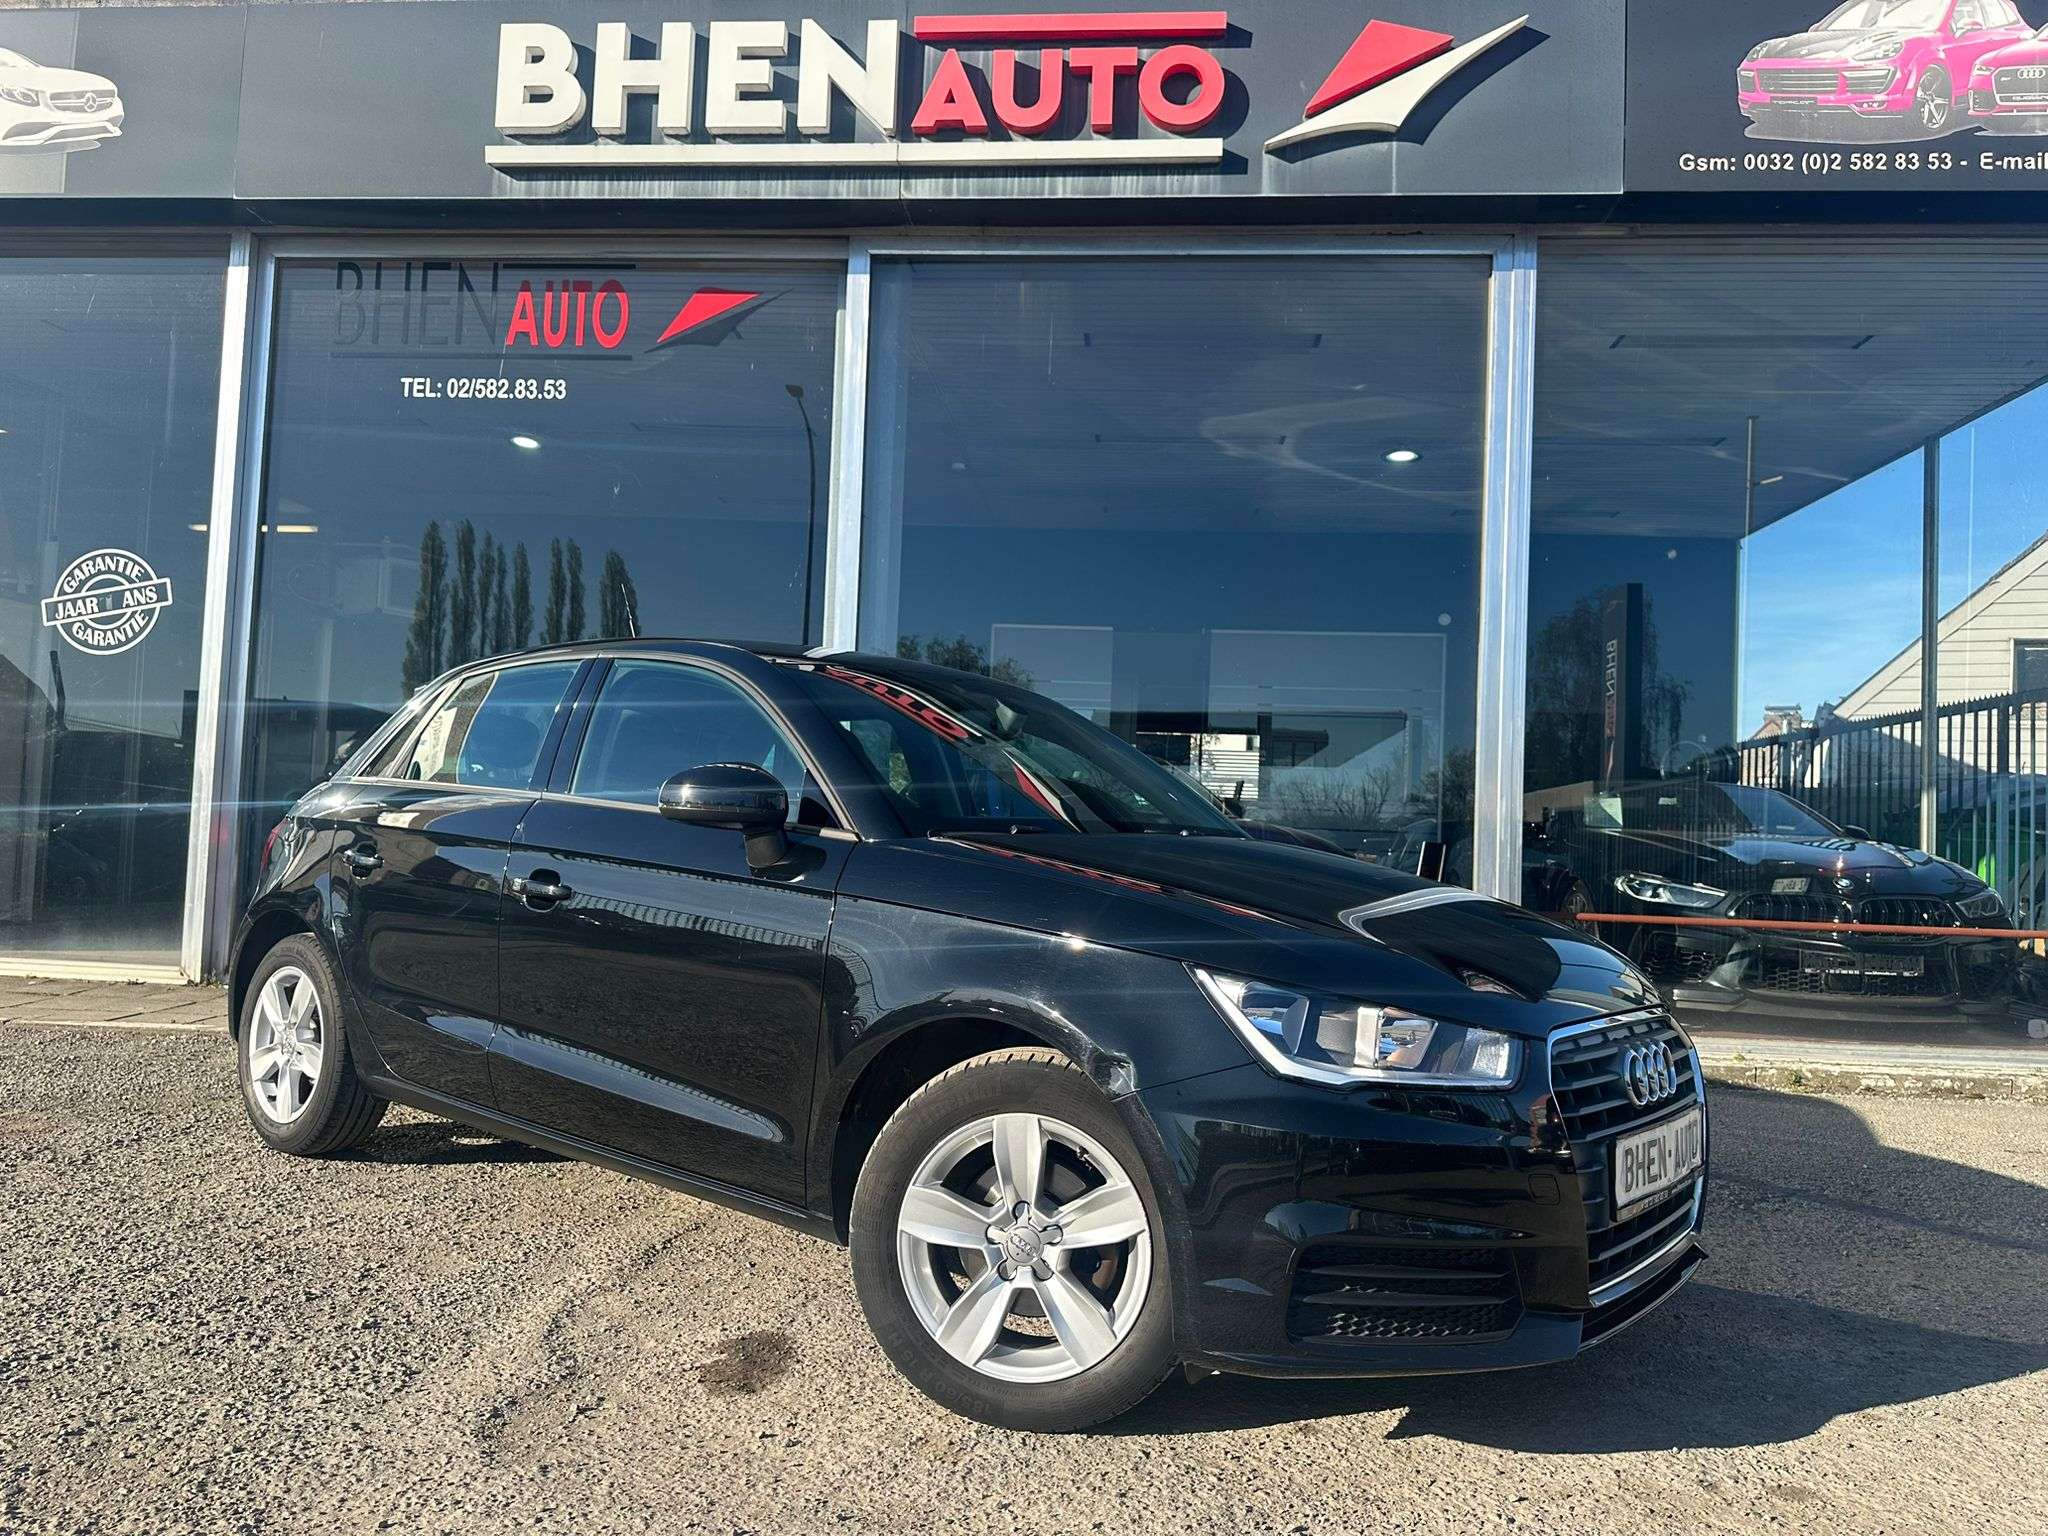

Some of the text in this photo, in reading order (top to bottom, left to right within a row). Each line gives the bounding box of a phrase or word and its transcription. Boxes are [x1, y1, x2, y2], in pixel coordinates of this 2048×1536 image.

[493, 19, 1225, 137] BHEN AUTO
[1679, 153, 1736, 171] Gsm:
[1743, 153, 1794, 171] 0032
[1802, 152, 1842, 175] (0)2
[1849, 153, 1887, 171] 582
[1894, 153, 1920, 171] 83
[1927, 153, 1952, 171] 53
[333, 261, 631, 349] BHEN AUTO
[401, 377, 567, 400] TEL: 02/582.83.53
[63, 555, 145, 593] GARANTIE
[55, 586, 158, 620] JAAR ANS
[72, 610, 149, 647] GARANTIE
